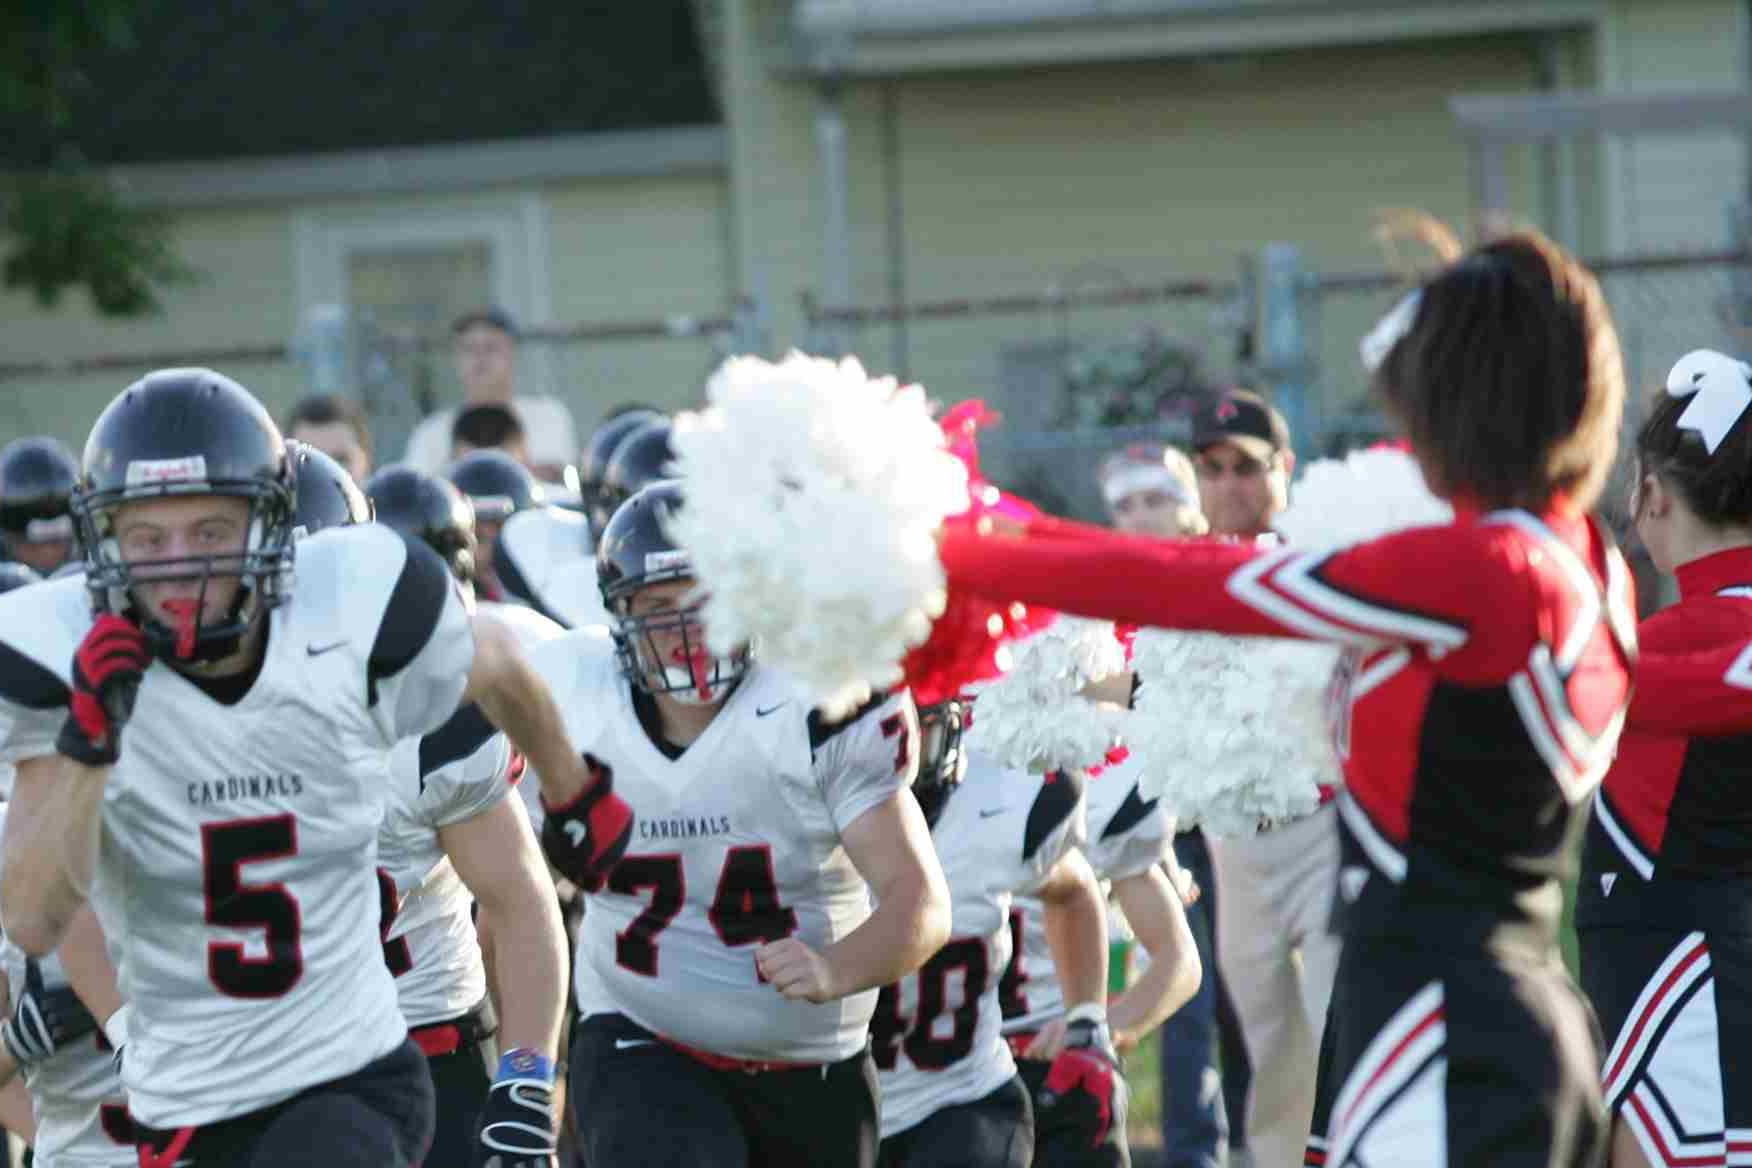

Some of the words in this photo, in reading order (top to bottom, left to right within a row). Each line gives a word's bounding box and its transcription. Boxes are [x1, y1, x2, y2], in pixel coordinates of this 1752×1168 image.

[188, 775, 302, 803] CARDINALS
[639, 816, 730, 839] CARDINALS
[201, 814, 304, 1000] 5
[607, 844, 798, 984] 74
